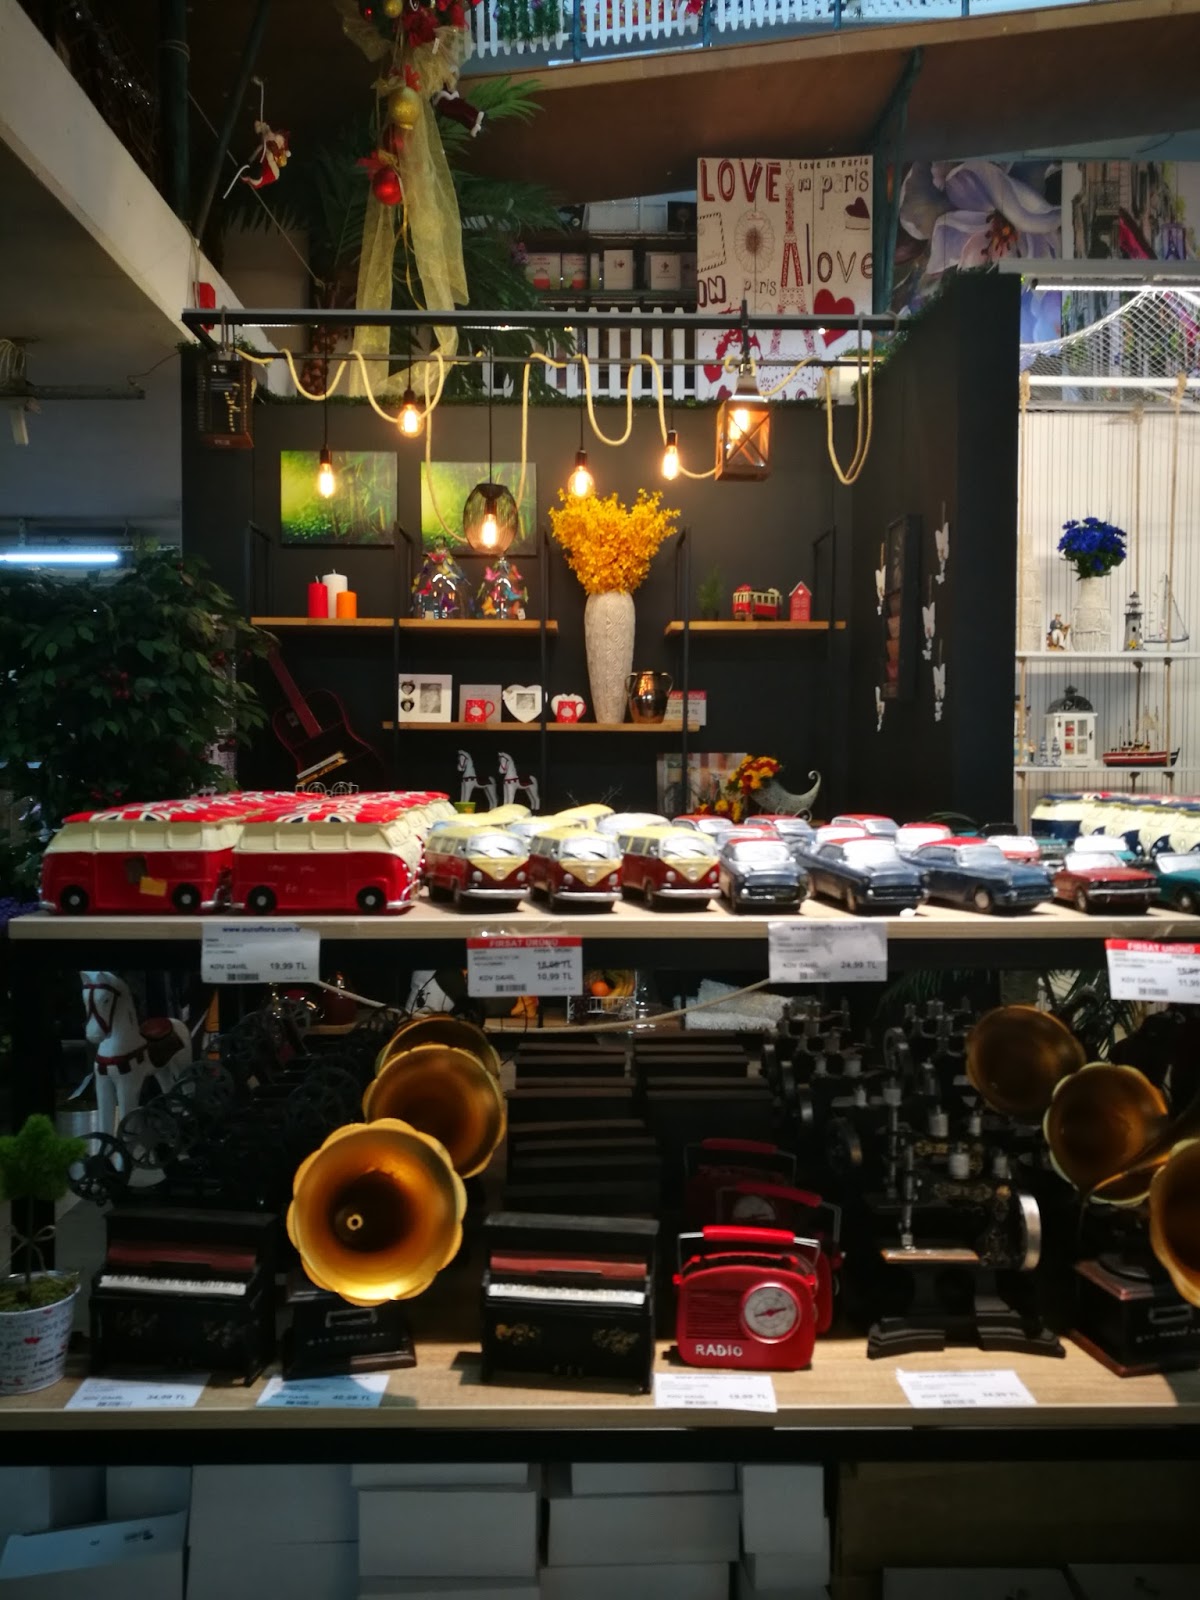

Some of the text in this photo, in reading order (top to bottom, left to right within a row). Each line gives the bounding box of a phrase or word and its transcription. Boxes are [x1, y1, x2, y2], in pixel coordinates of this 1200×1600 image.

[700, 158, 781, 203] LOVE
[820, 169, 869, 211] paris
[489, 939, 522, 948] FIRSAT
[1127, 941, 1161, 953] FIRSAT
[296, 962, 307, 970] TL
[537, 972, 560, 981] 10,99
[563, 972, 573, 980] TL
